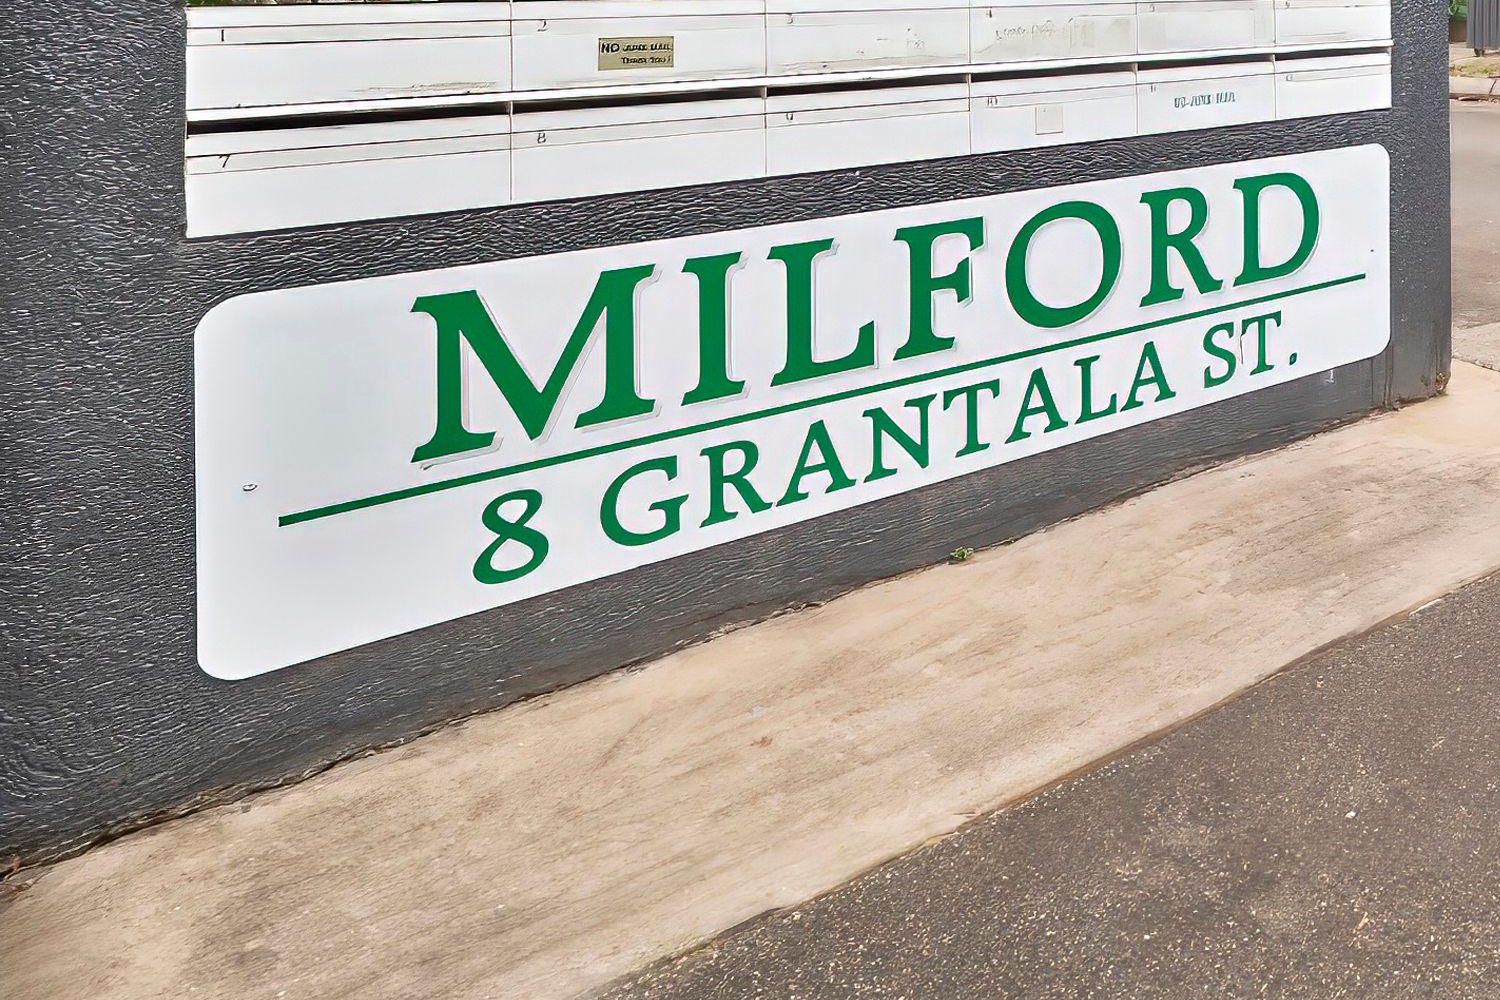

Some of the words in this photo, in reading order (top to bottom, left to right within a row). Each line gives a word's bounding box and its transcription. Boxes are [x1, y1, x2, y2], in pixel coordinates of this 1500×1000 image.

[411, 170, 1322, 464] MILFORD
[472, 487, 549, 584] 8
[600, 340, 1177, 547] GRANTALA
[1203, 311, 1299, 388] ST.
